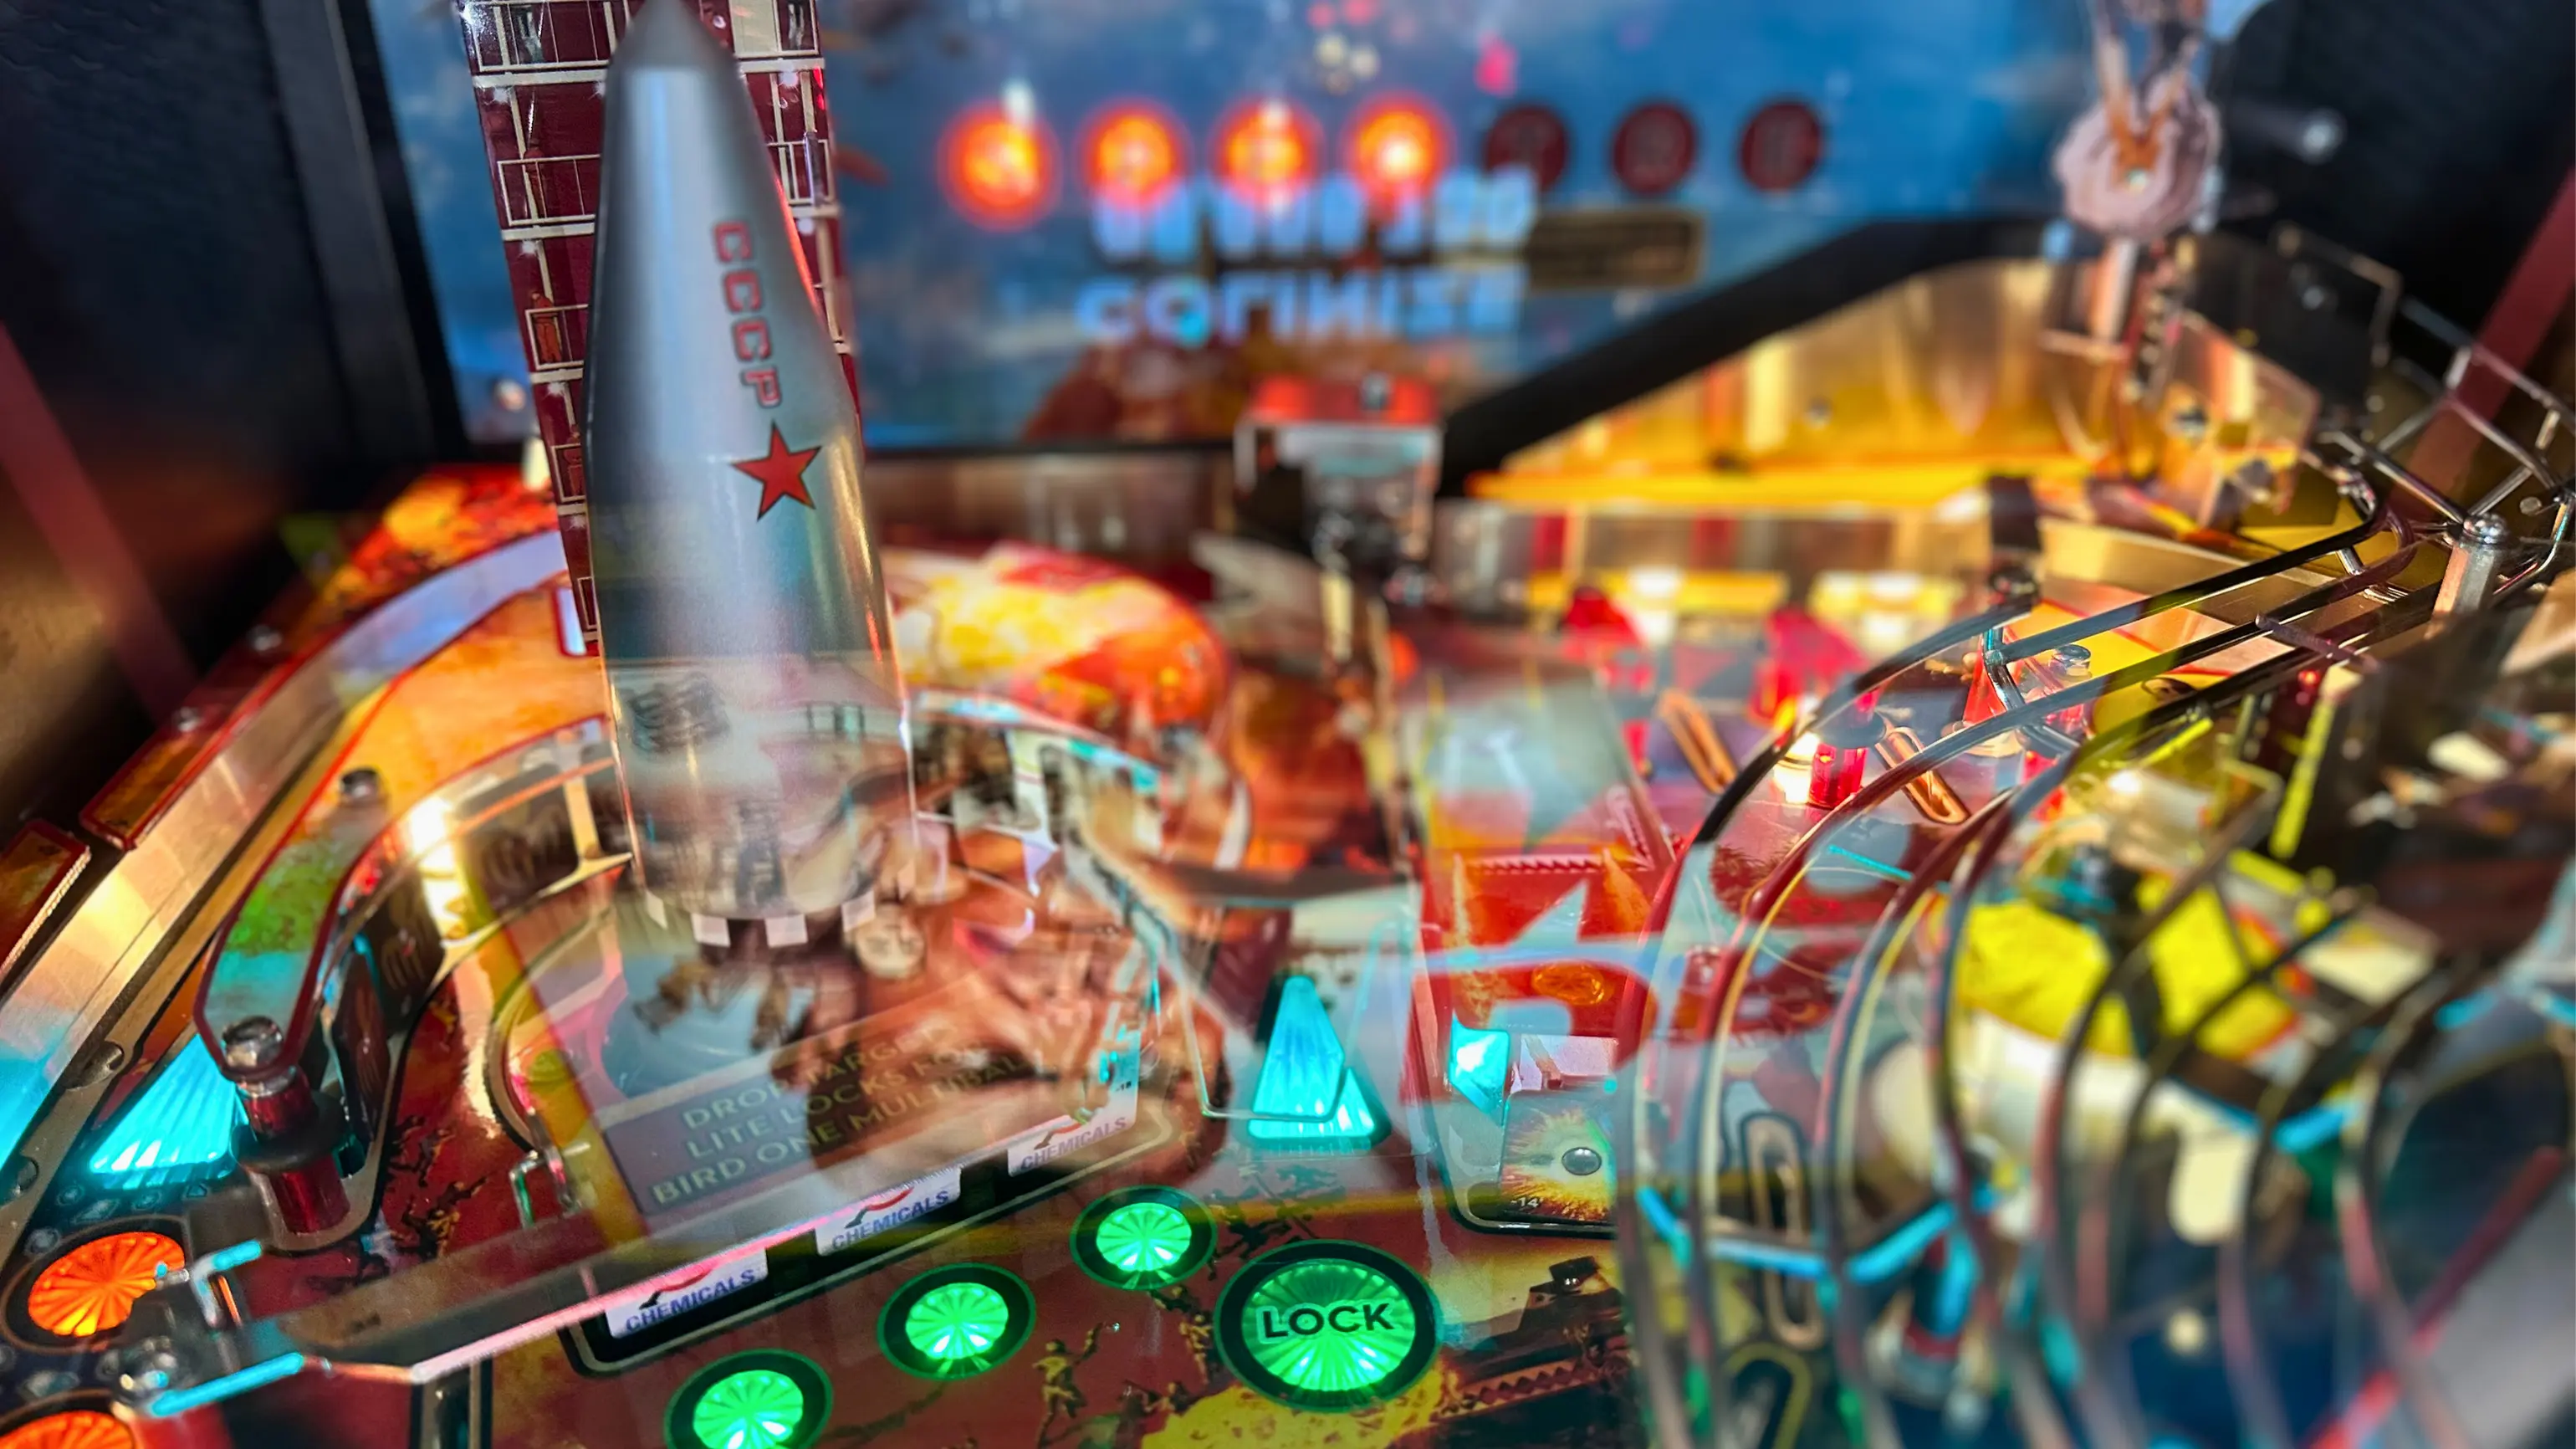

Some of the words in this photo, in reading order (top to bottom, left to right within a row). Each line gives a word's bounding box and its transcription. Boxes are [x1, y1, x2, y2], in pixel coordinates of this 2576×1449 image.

[651, 1156, 747, 1206] BIRD
[756, 1120, 842, 1165] ONE
[848, 1048, 1035, 1131] MULTIBAL
[686, 1113, 772, 1160] LITE
[779, 1069, 907, 1124] LOCKS
[1020, 1116, 1127, 1170] CHEMICALS
[831, 1189, 949, 1252] CHEMICALS
[626, 1268, 755, 1332] CHEMICALS
[1262, 1303, 1395, 1339] LOCK
